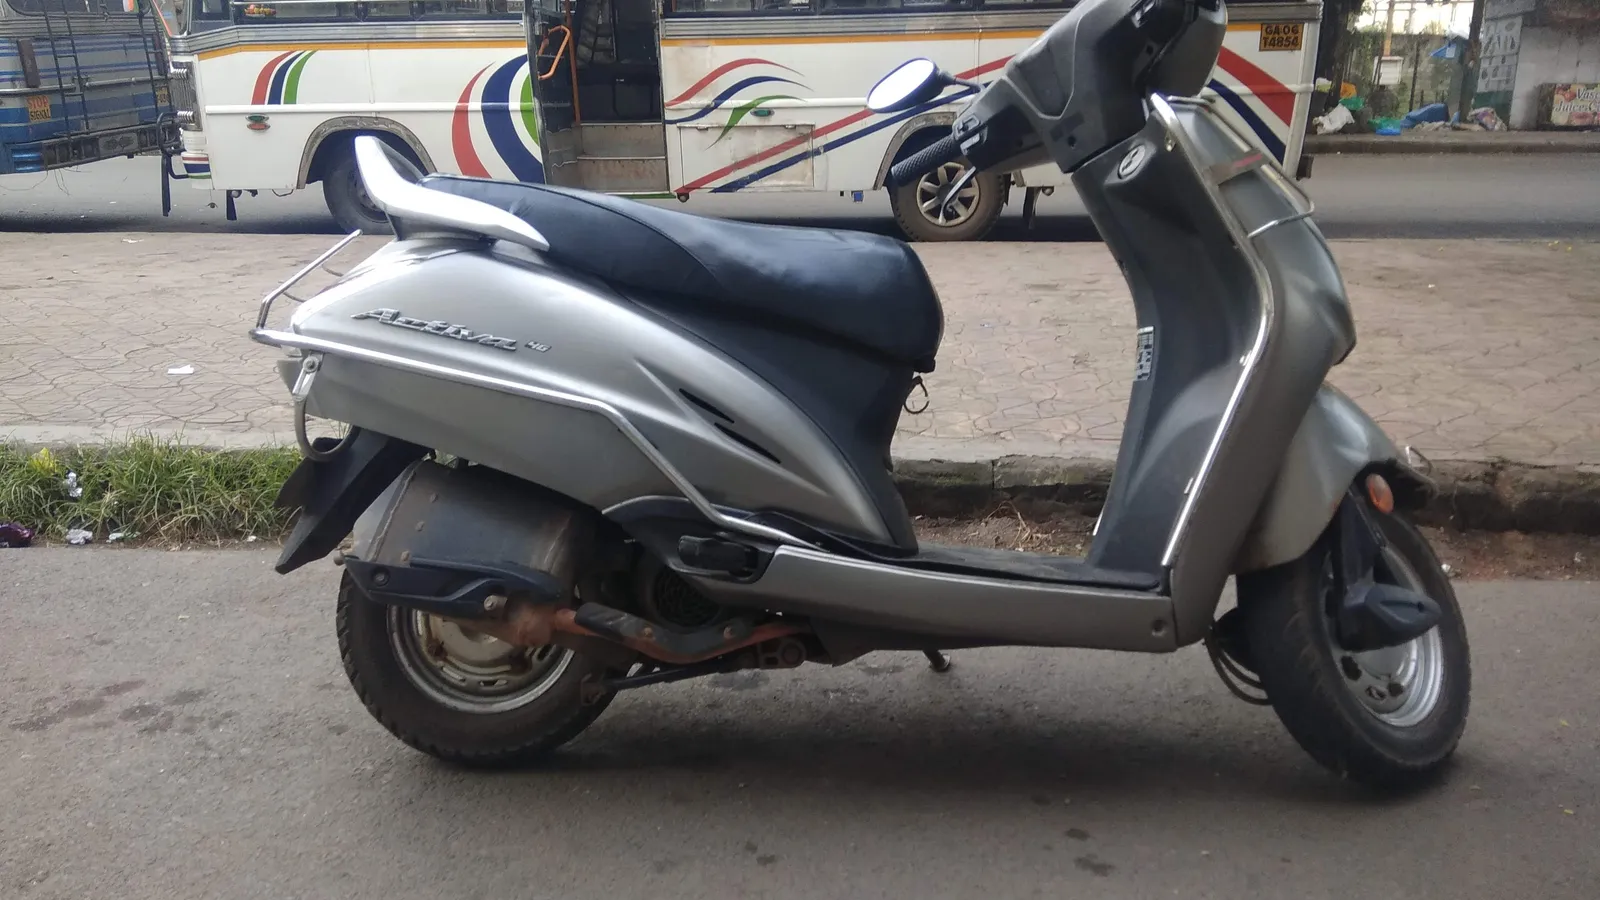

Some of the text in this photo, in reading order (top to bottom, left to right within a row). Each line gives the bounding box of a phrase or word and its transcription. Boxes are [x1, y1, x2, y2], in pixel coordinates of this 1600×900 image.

[1265, 25, 1298, 35] GA 06
[1263, 36, 1299, 48] T4854
[28, 95, 49, 109] STOP
[351, 308, 552, 353] Activa 4G
